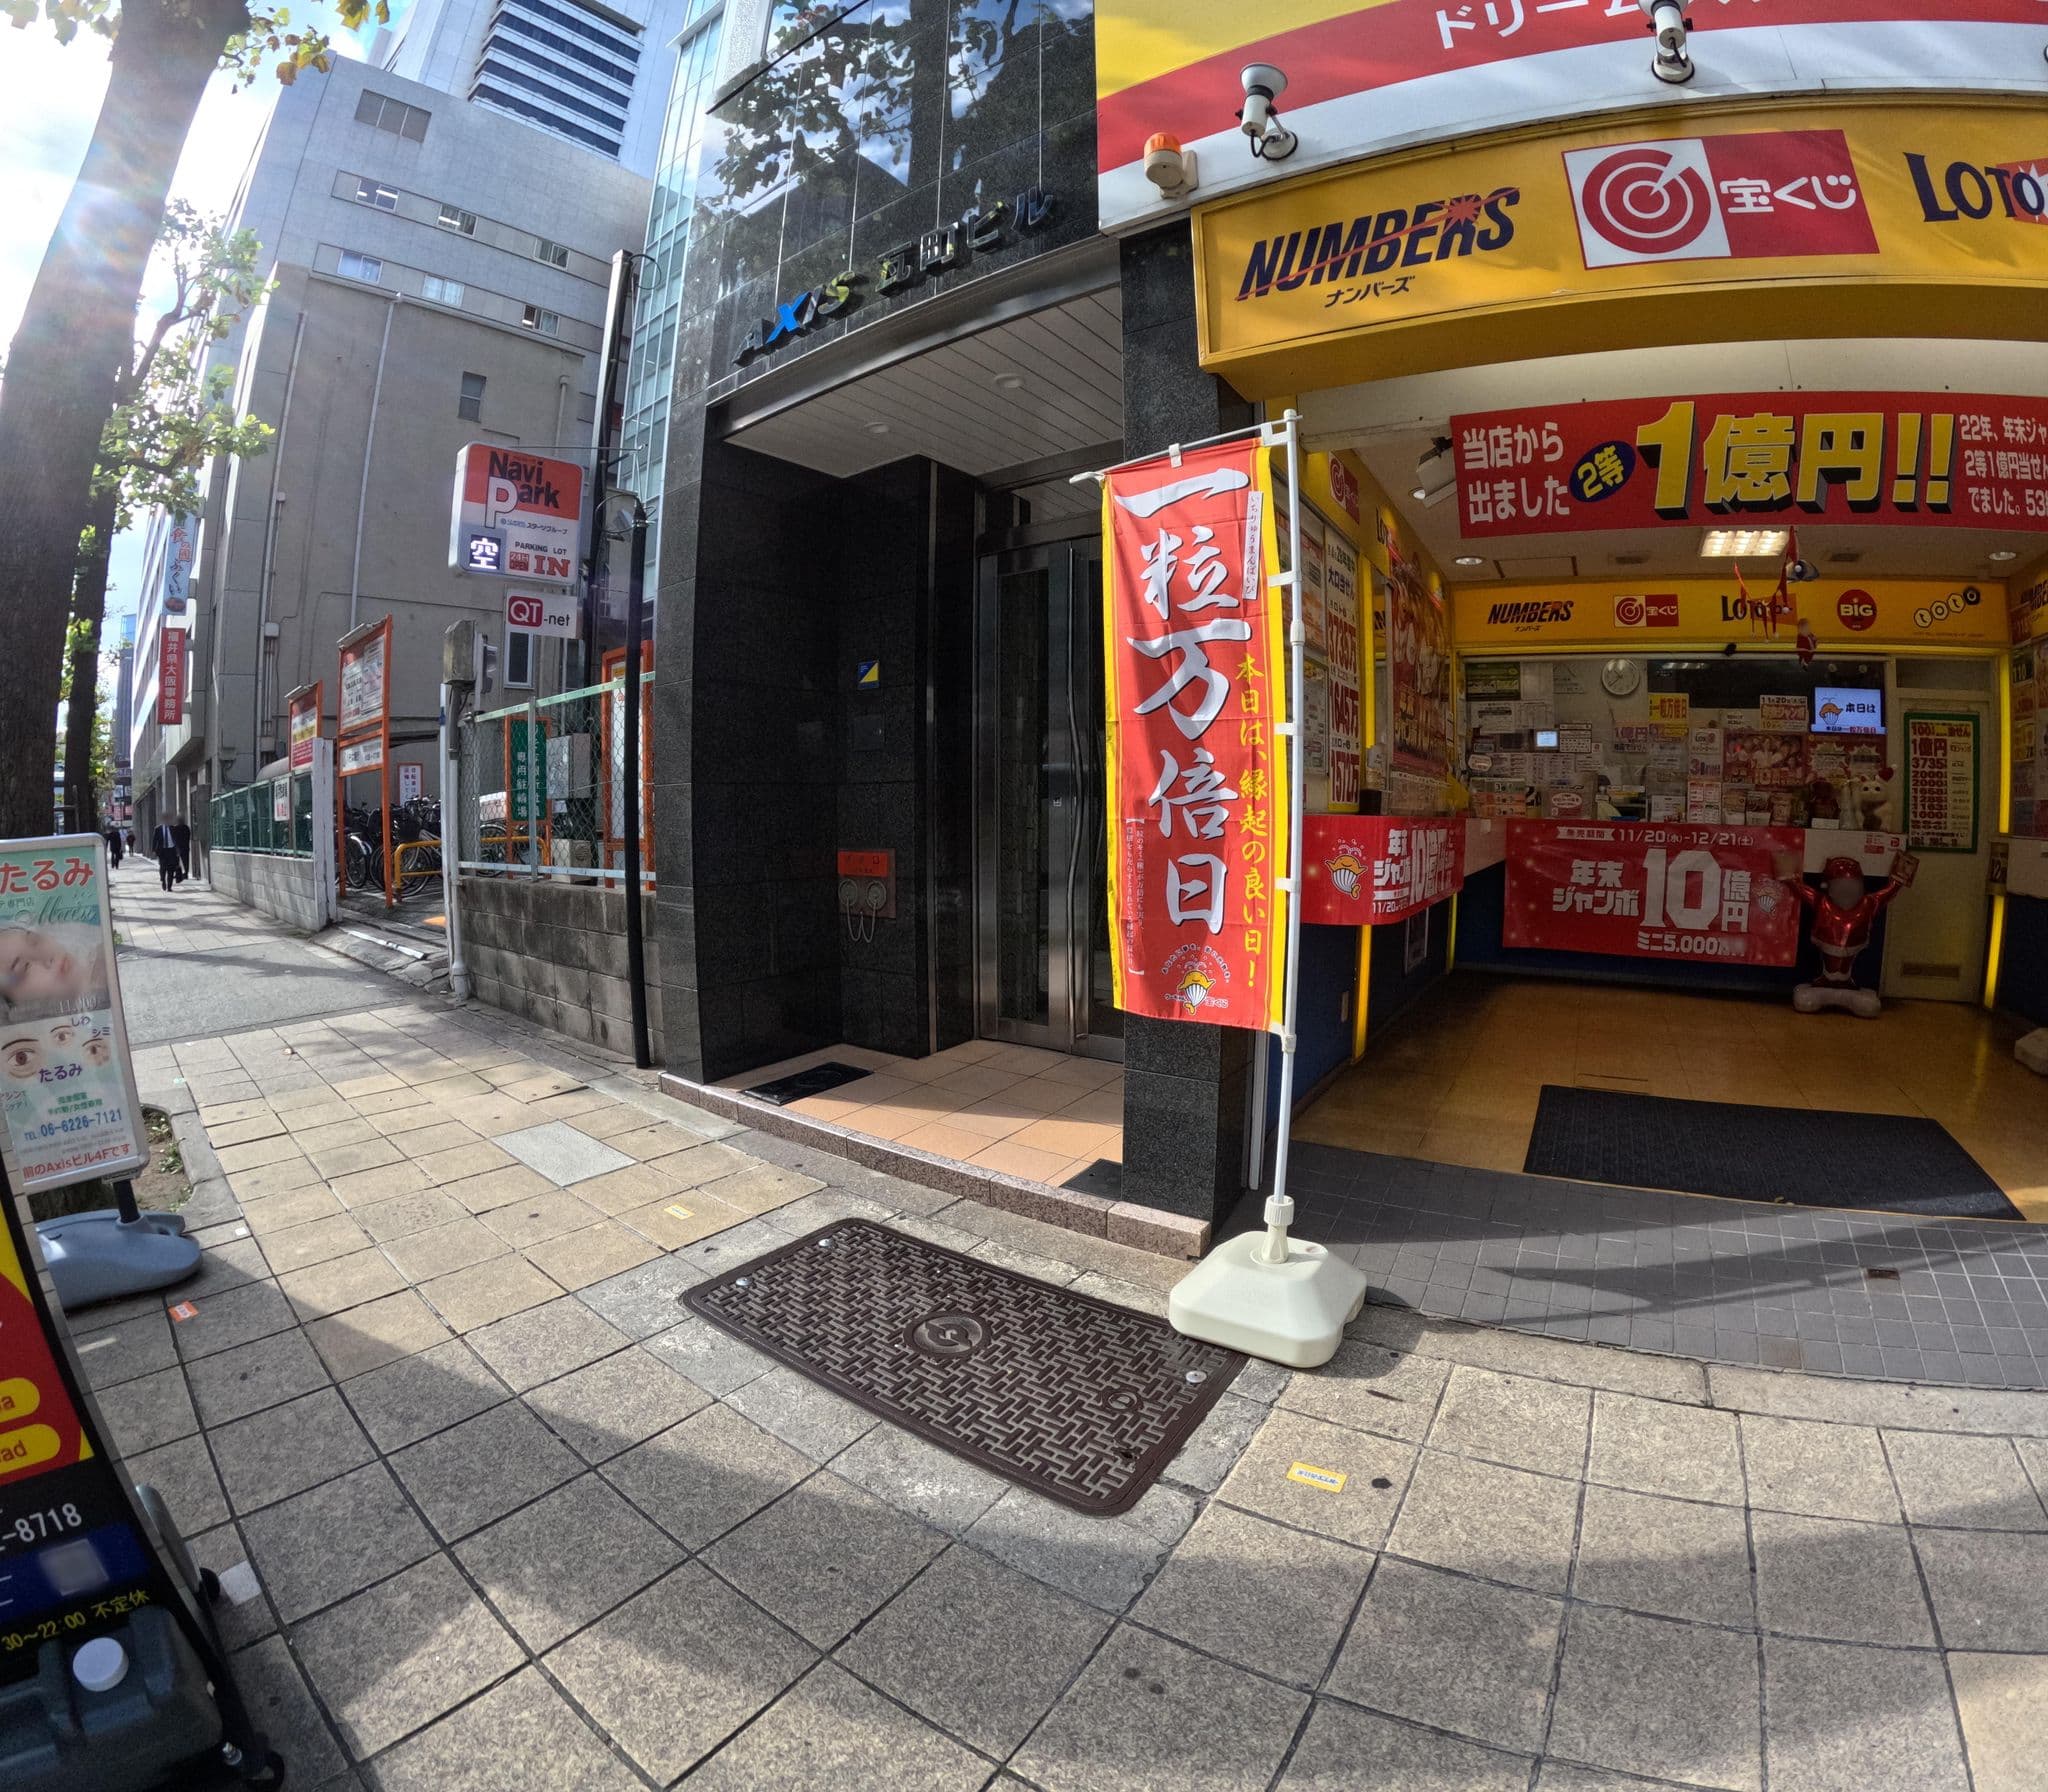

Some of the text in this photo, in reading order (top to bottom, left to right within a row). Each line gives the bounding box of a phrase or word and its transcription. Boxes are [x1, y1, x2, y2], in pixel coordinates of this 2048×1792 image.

[1719, 174, 1857, 215] 宝くじ
[1236, 187, 1519, 300] NUMBERS
[1325, 275, 1415, 308] ナンバーズ
[1462, 421, 1565, 470] 当店から
[489, 451, 543, 484] Navi
[1577, 445, 1625, 499] 2等
[485, 476, 560, 529] Park
[1468, 475, 1570, 524] 出ました
[469, 537, 498, 570] 空
[514, 541, 567, 555] PARKING LOT
[534, 555, 571, 578] IN
[1487, 600, 1574, 625] NUMBERS
[1646, 604, 1678, 617] 宝くじ
[163, 631, 179, 720] 福井県大阪事務所
[1114, 468, 1252, 935] 一粒万倍日
[1845, 702, 1876, 714] 本日は
[0, 858, 94, 894] たるみ
[1570, 859, 1624, 888] 年末
[1552, 886, 1640, 917] ジャンボ
[91, 1026, 111, 1038] シミ
[38, 1063, 83, 1084] たるみ
[0, 1440, 27, 1463] ad
[94, 1589, 151, 1621] 不定休
